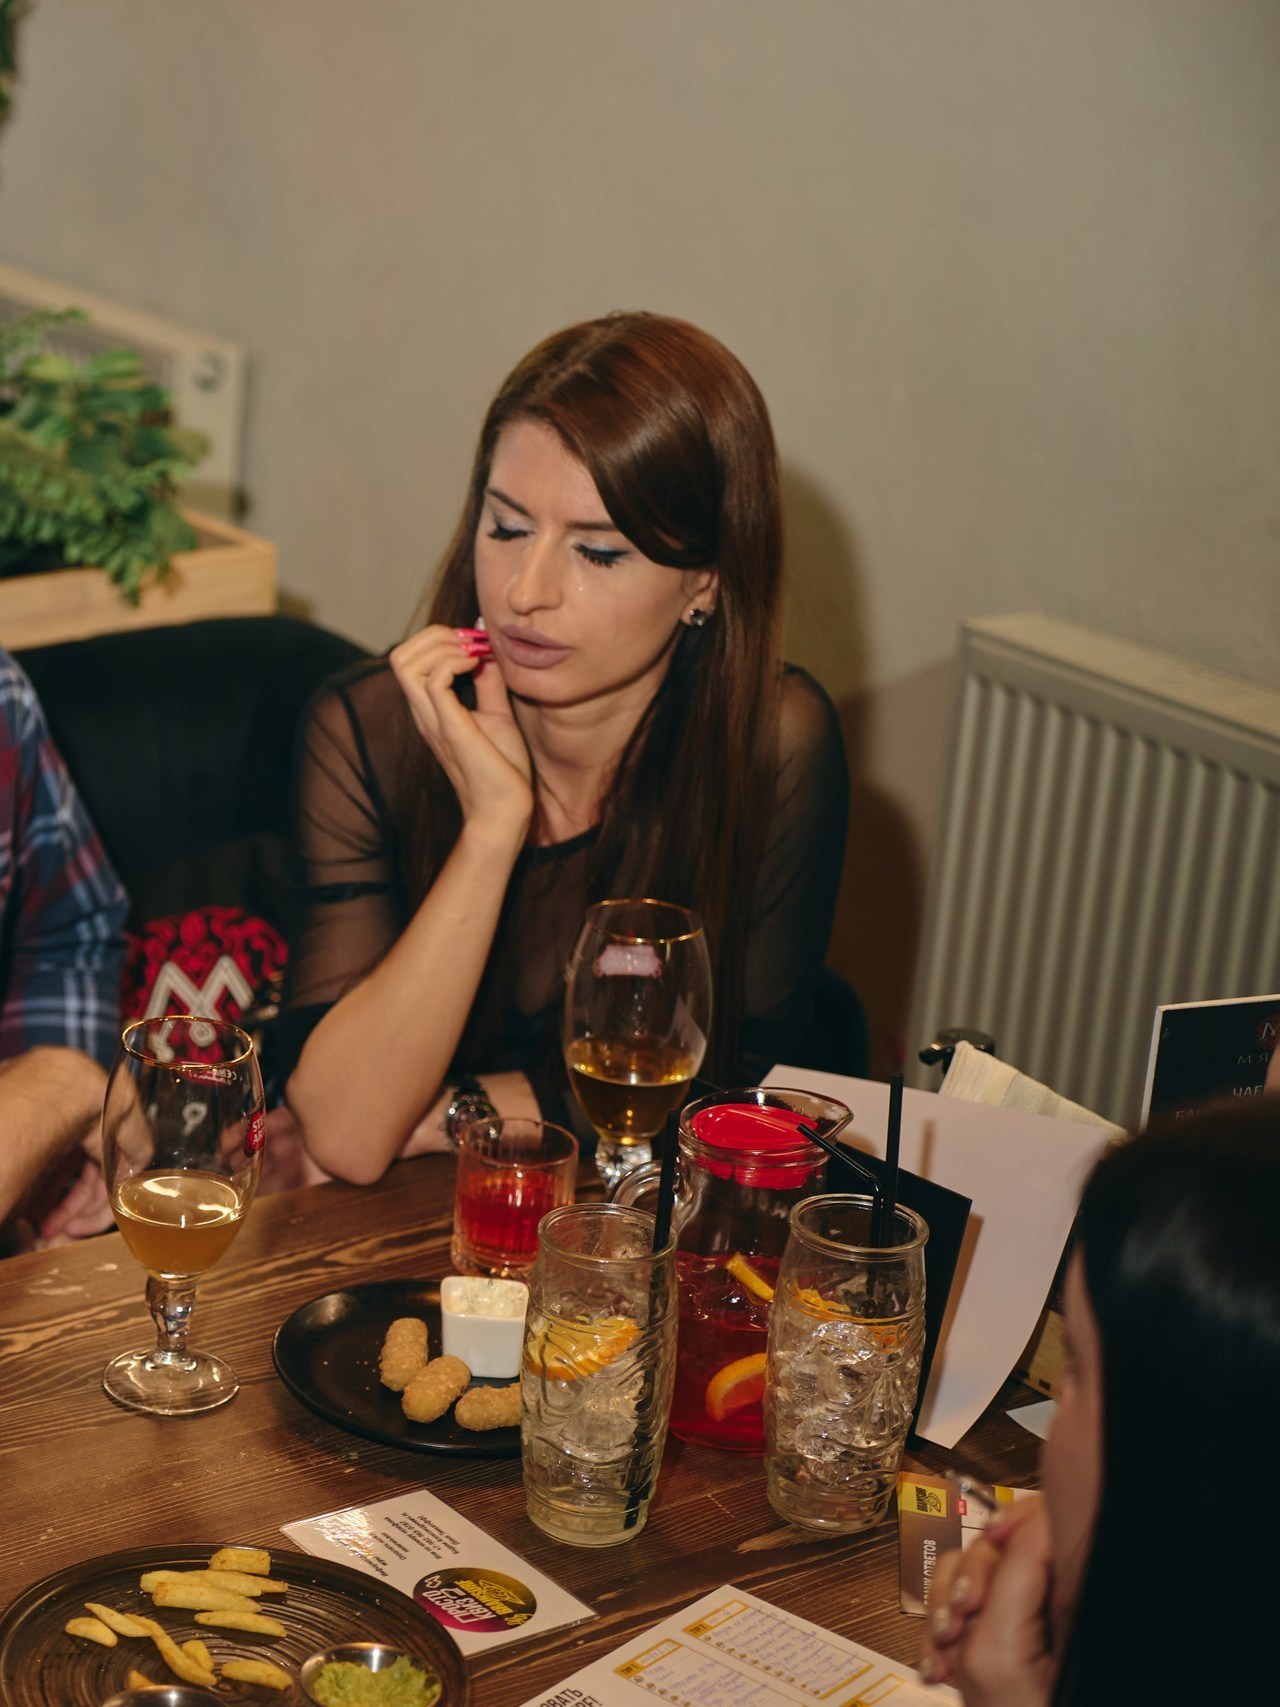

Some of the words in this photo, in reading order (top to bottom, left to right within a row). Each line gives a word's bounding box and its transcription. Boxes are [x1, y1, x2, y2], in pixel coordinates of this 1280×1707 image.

[1237, 1052, 1269, 1065] МЯ
[1233, 1084, 1267, 1097] ЧАЕ
[422, 1590, 474, 1623] ПРОСТО
[454, 1579, 514, 1615] BRAINSURF
[455, 1594, 496, 1621] КВИЗ
